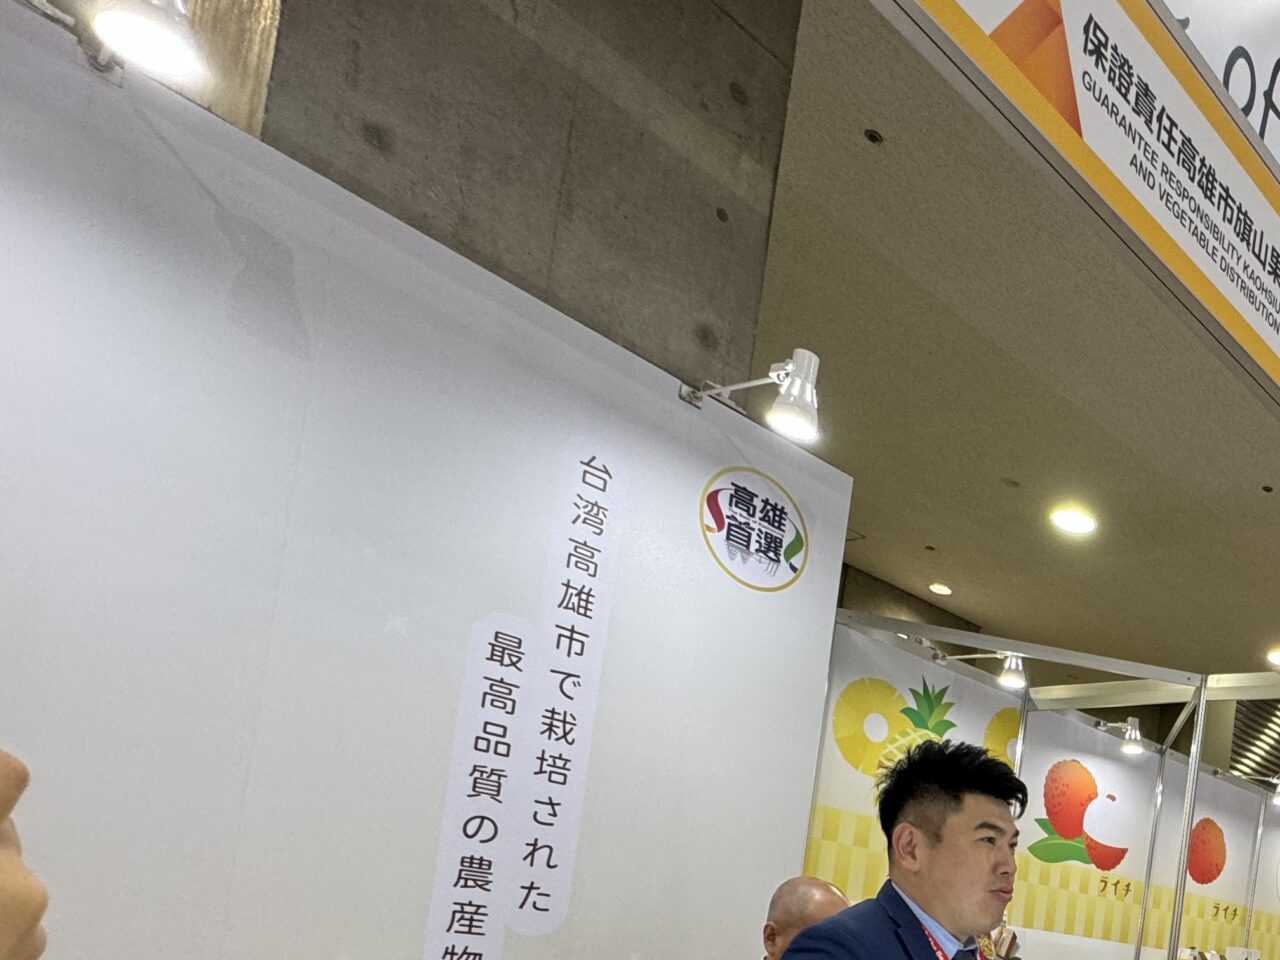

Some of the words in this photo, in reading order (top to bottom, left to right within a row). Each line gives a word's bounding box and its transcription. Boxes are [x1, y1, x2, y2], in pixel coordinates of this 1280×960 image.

[1082, 71, 1158, 170] GUARANTEE
[1161, 162, 1242, 266] RESPONSIBILITY
[1130, 154, 1156, 190] AND
[1159, 182, 1218, 264] VEGETABLE
[1219, 256, 1280, 335] DISTRIBUTION
[728, 482, 788, 533] 高雄
[725, 515, 783, 563] 首選
[518, 454, 613, 914] 台湾高雄市で栽培された
[1100, 876, 1132, 898] ライチ
[1212, 903, 1239, 921] ライチ
